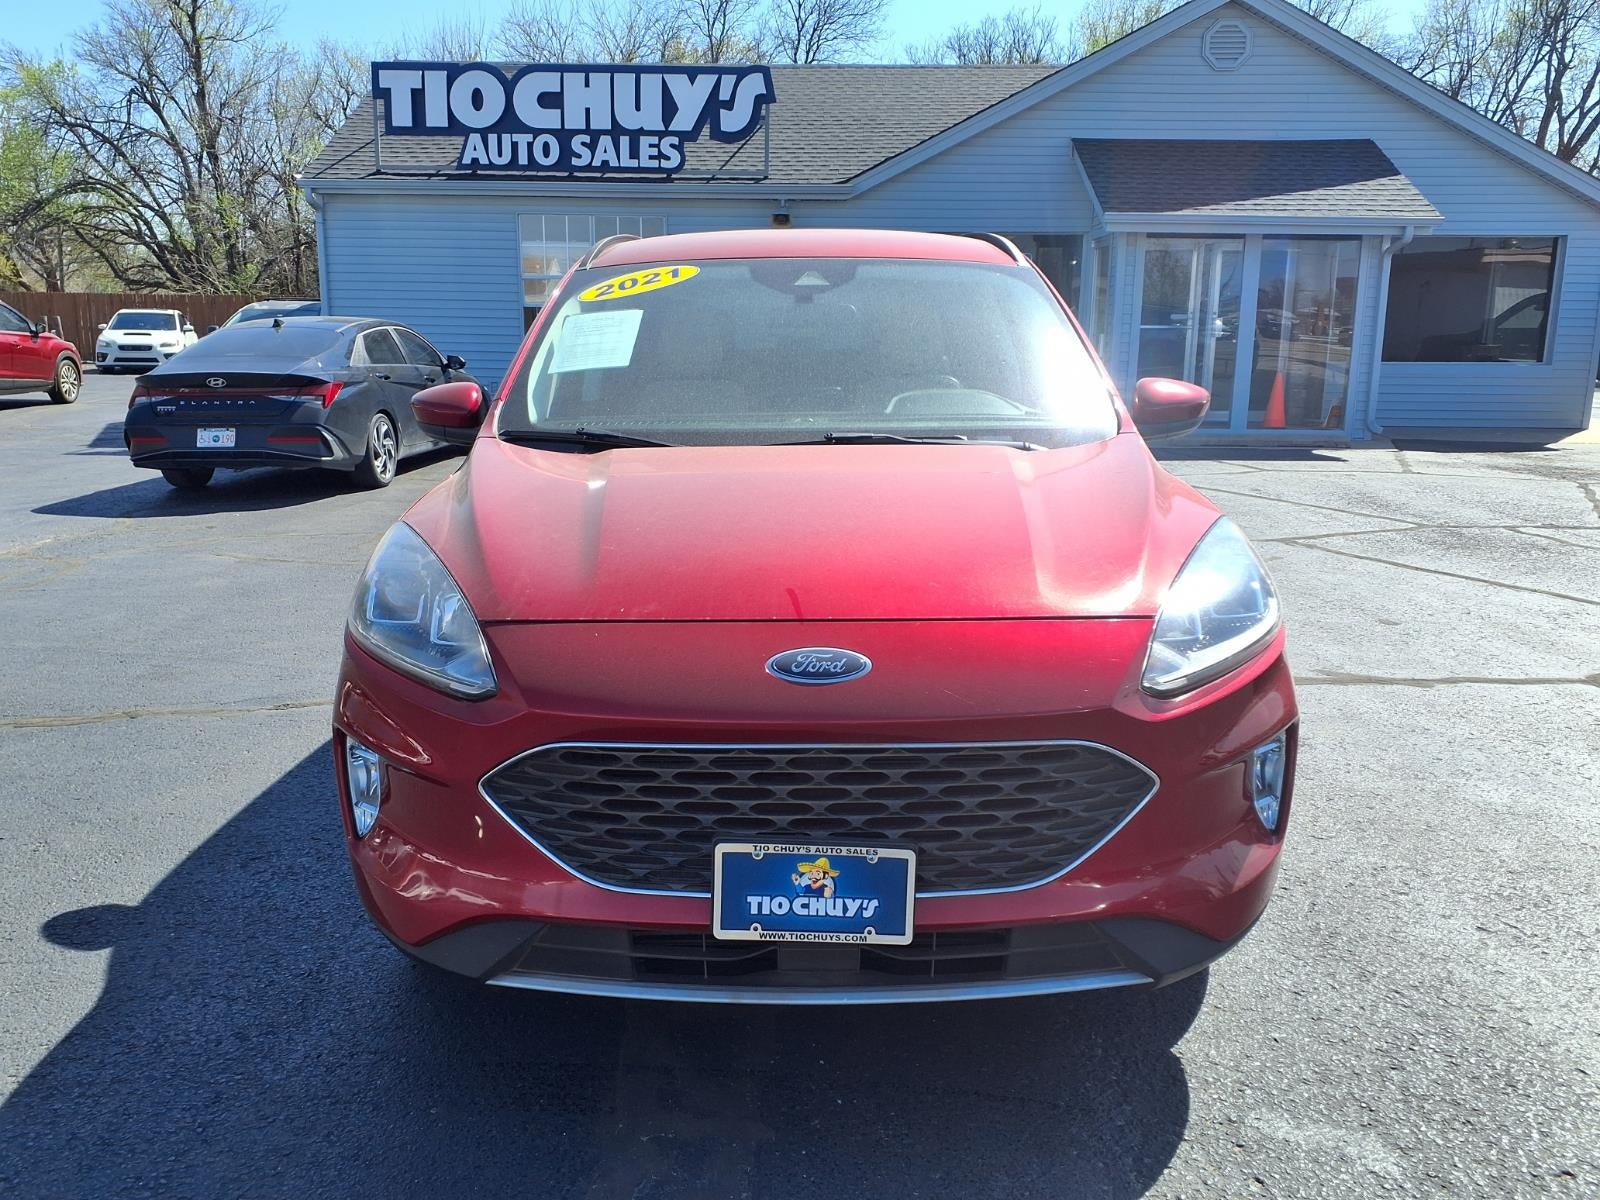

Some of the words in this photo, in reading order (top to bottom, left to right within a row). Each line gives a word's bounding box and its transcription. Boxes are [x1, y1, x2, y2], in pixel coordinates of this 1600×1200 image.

[379, 69, 506, 128] TIO
[512, 72, 767, 132] CHUY'S
[461, 133, 560, 166] AUTO
[571, 136, 681, 168] SALES
[595, 267, 681, 298] 2021
[791, 653, 848, 673] Ford
[814, 847, 843, 855] AUTO
[846, 848, 879, 856] SALES
[747, 896, 789, 915] TIO
[792, 896, 879, 918] CHUY'S
[759, 932, 868, 943] WWW.TIOCHUYS.COM
